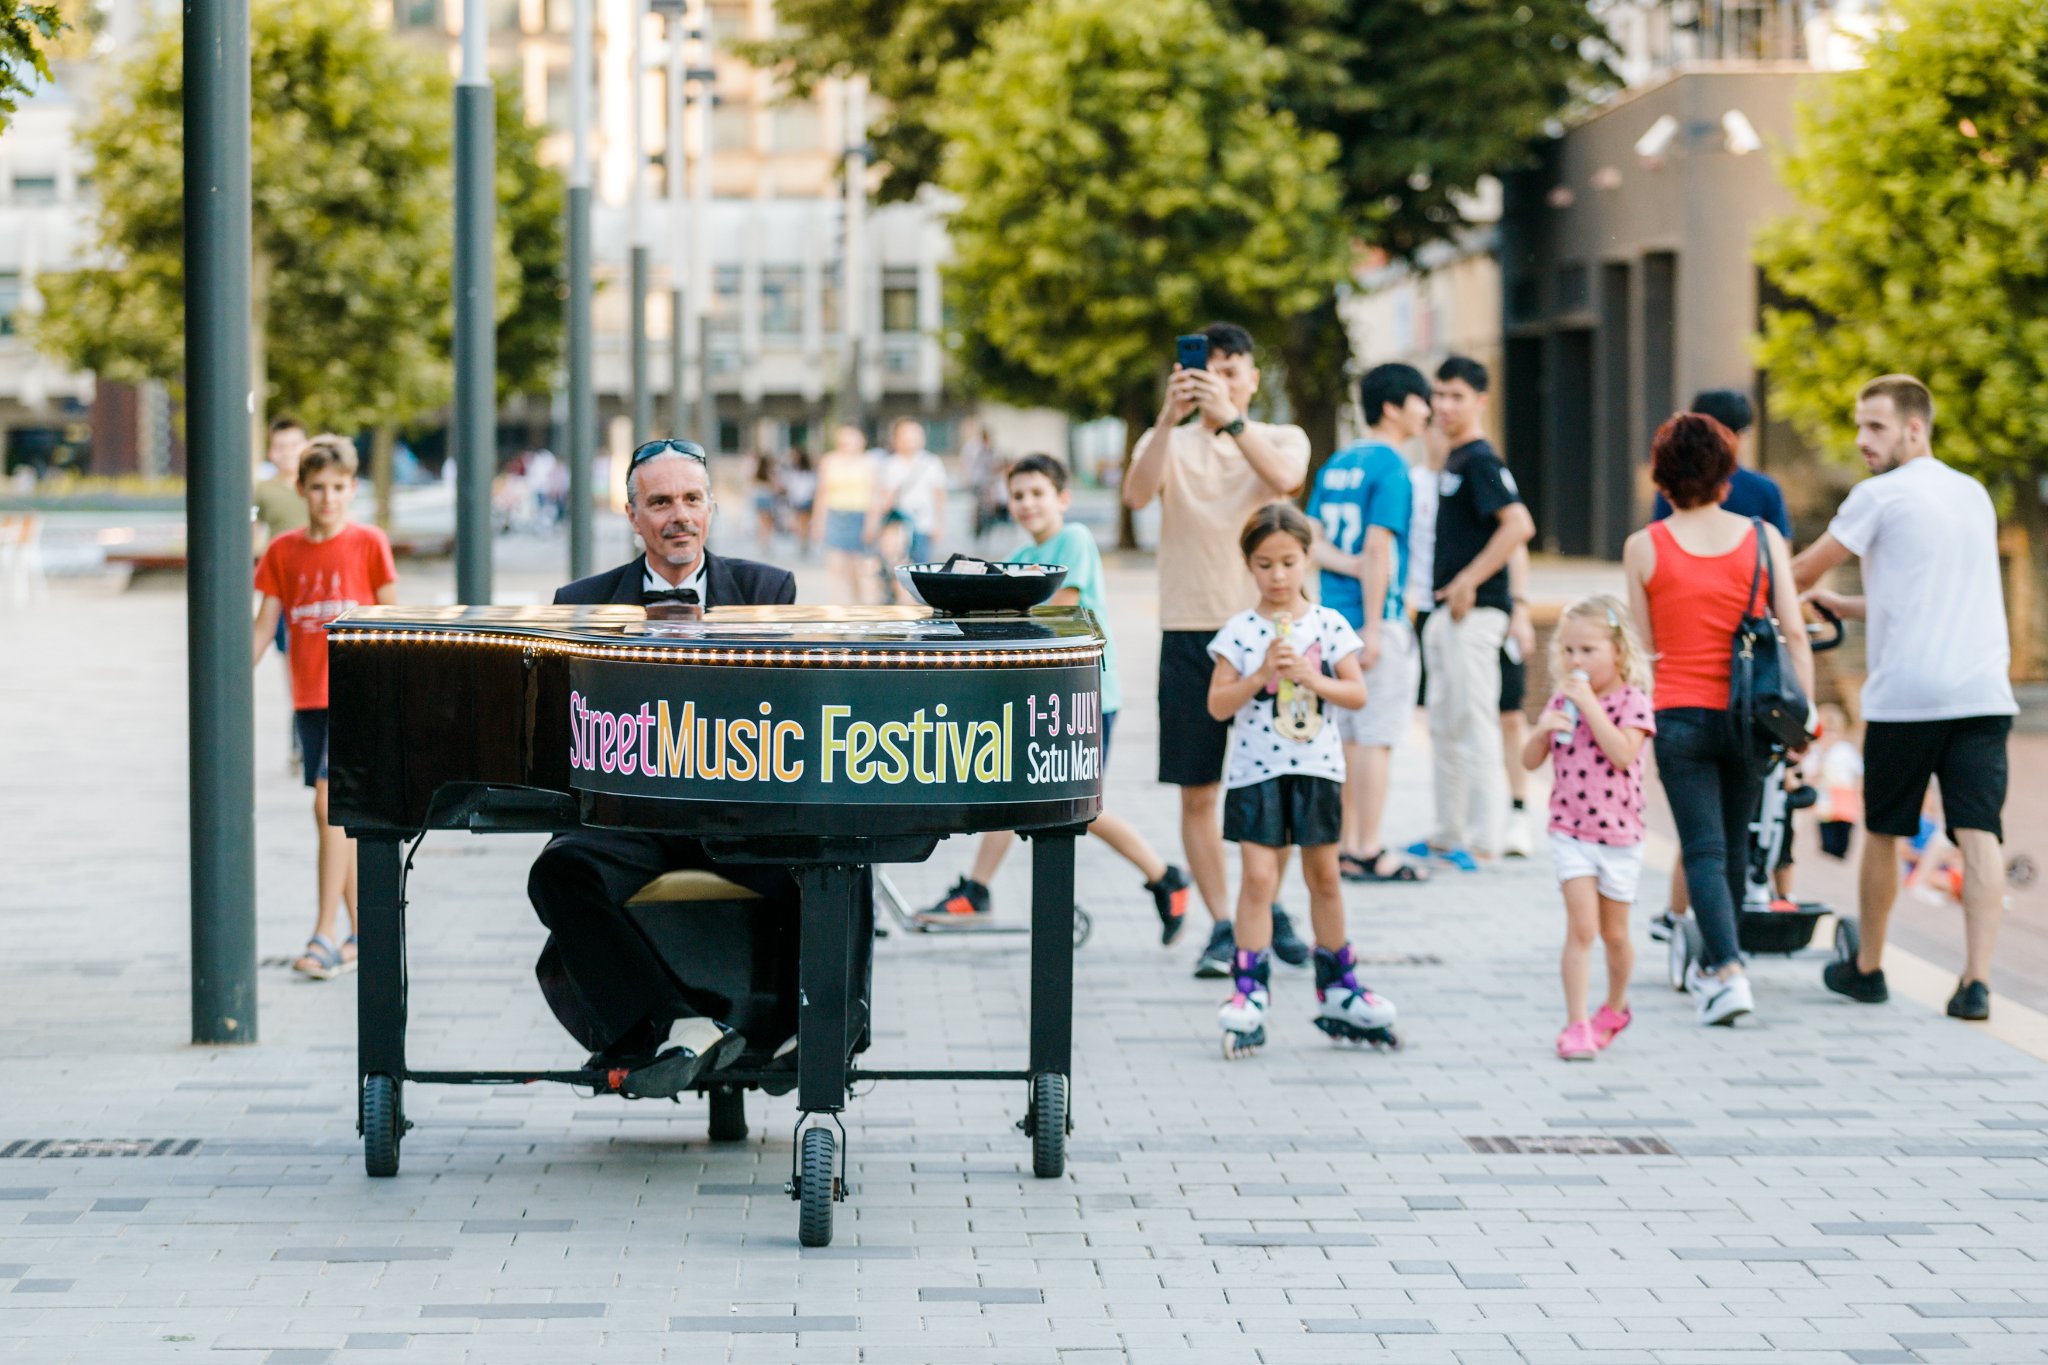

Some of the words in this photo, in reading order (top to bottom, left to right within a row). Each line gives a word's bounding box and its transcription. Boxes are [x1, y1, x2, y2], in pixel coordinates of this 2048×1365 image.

[1027, 693, 1060, 737] 1-3
[1066, 691, 1098, 736] JULY
[820, 701, 1014, 784] Festival
[1026, 741, 1068, 784] Satu
